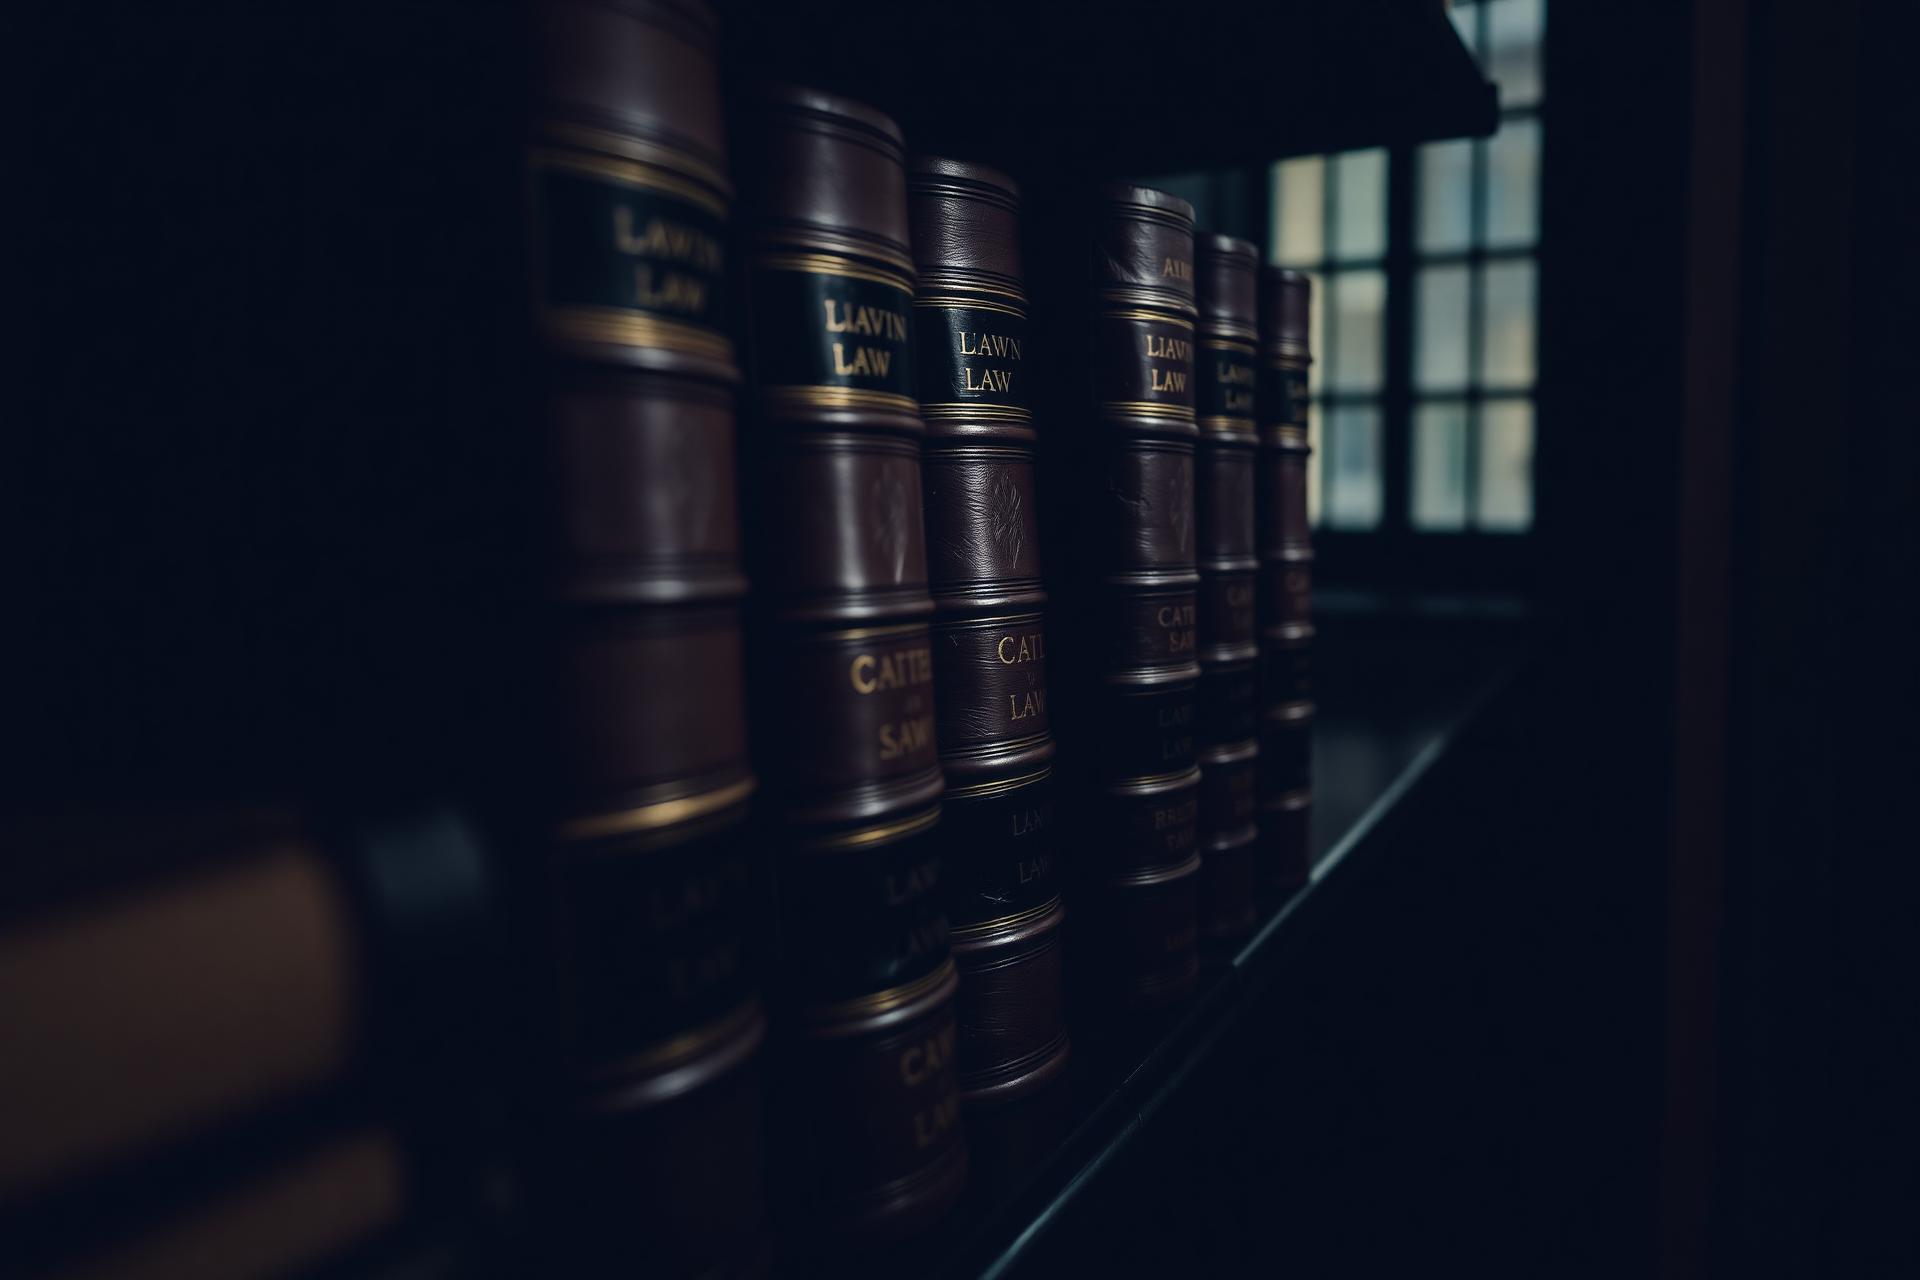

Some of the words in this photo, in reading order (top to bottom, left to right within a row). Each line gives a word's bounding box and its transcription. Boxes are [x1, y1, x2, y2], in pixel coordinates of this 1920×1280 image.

[833, 342, 892, 378] LAW
[965, 367, 1012, 393] LAW
[1152, 368, 1186, 393] LAW
